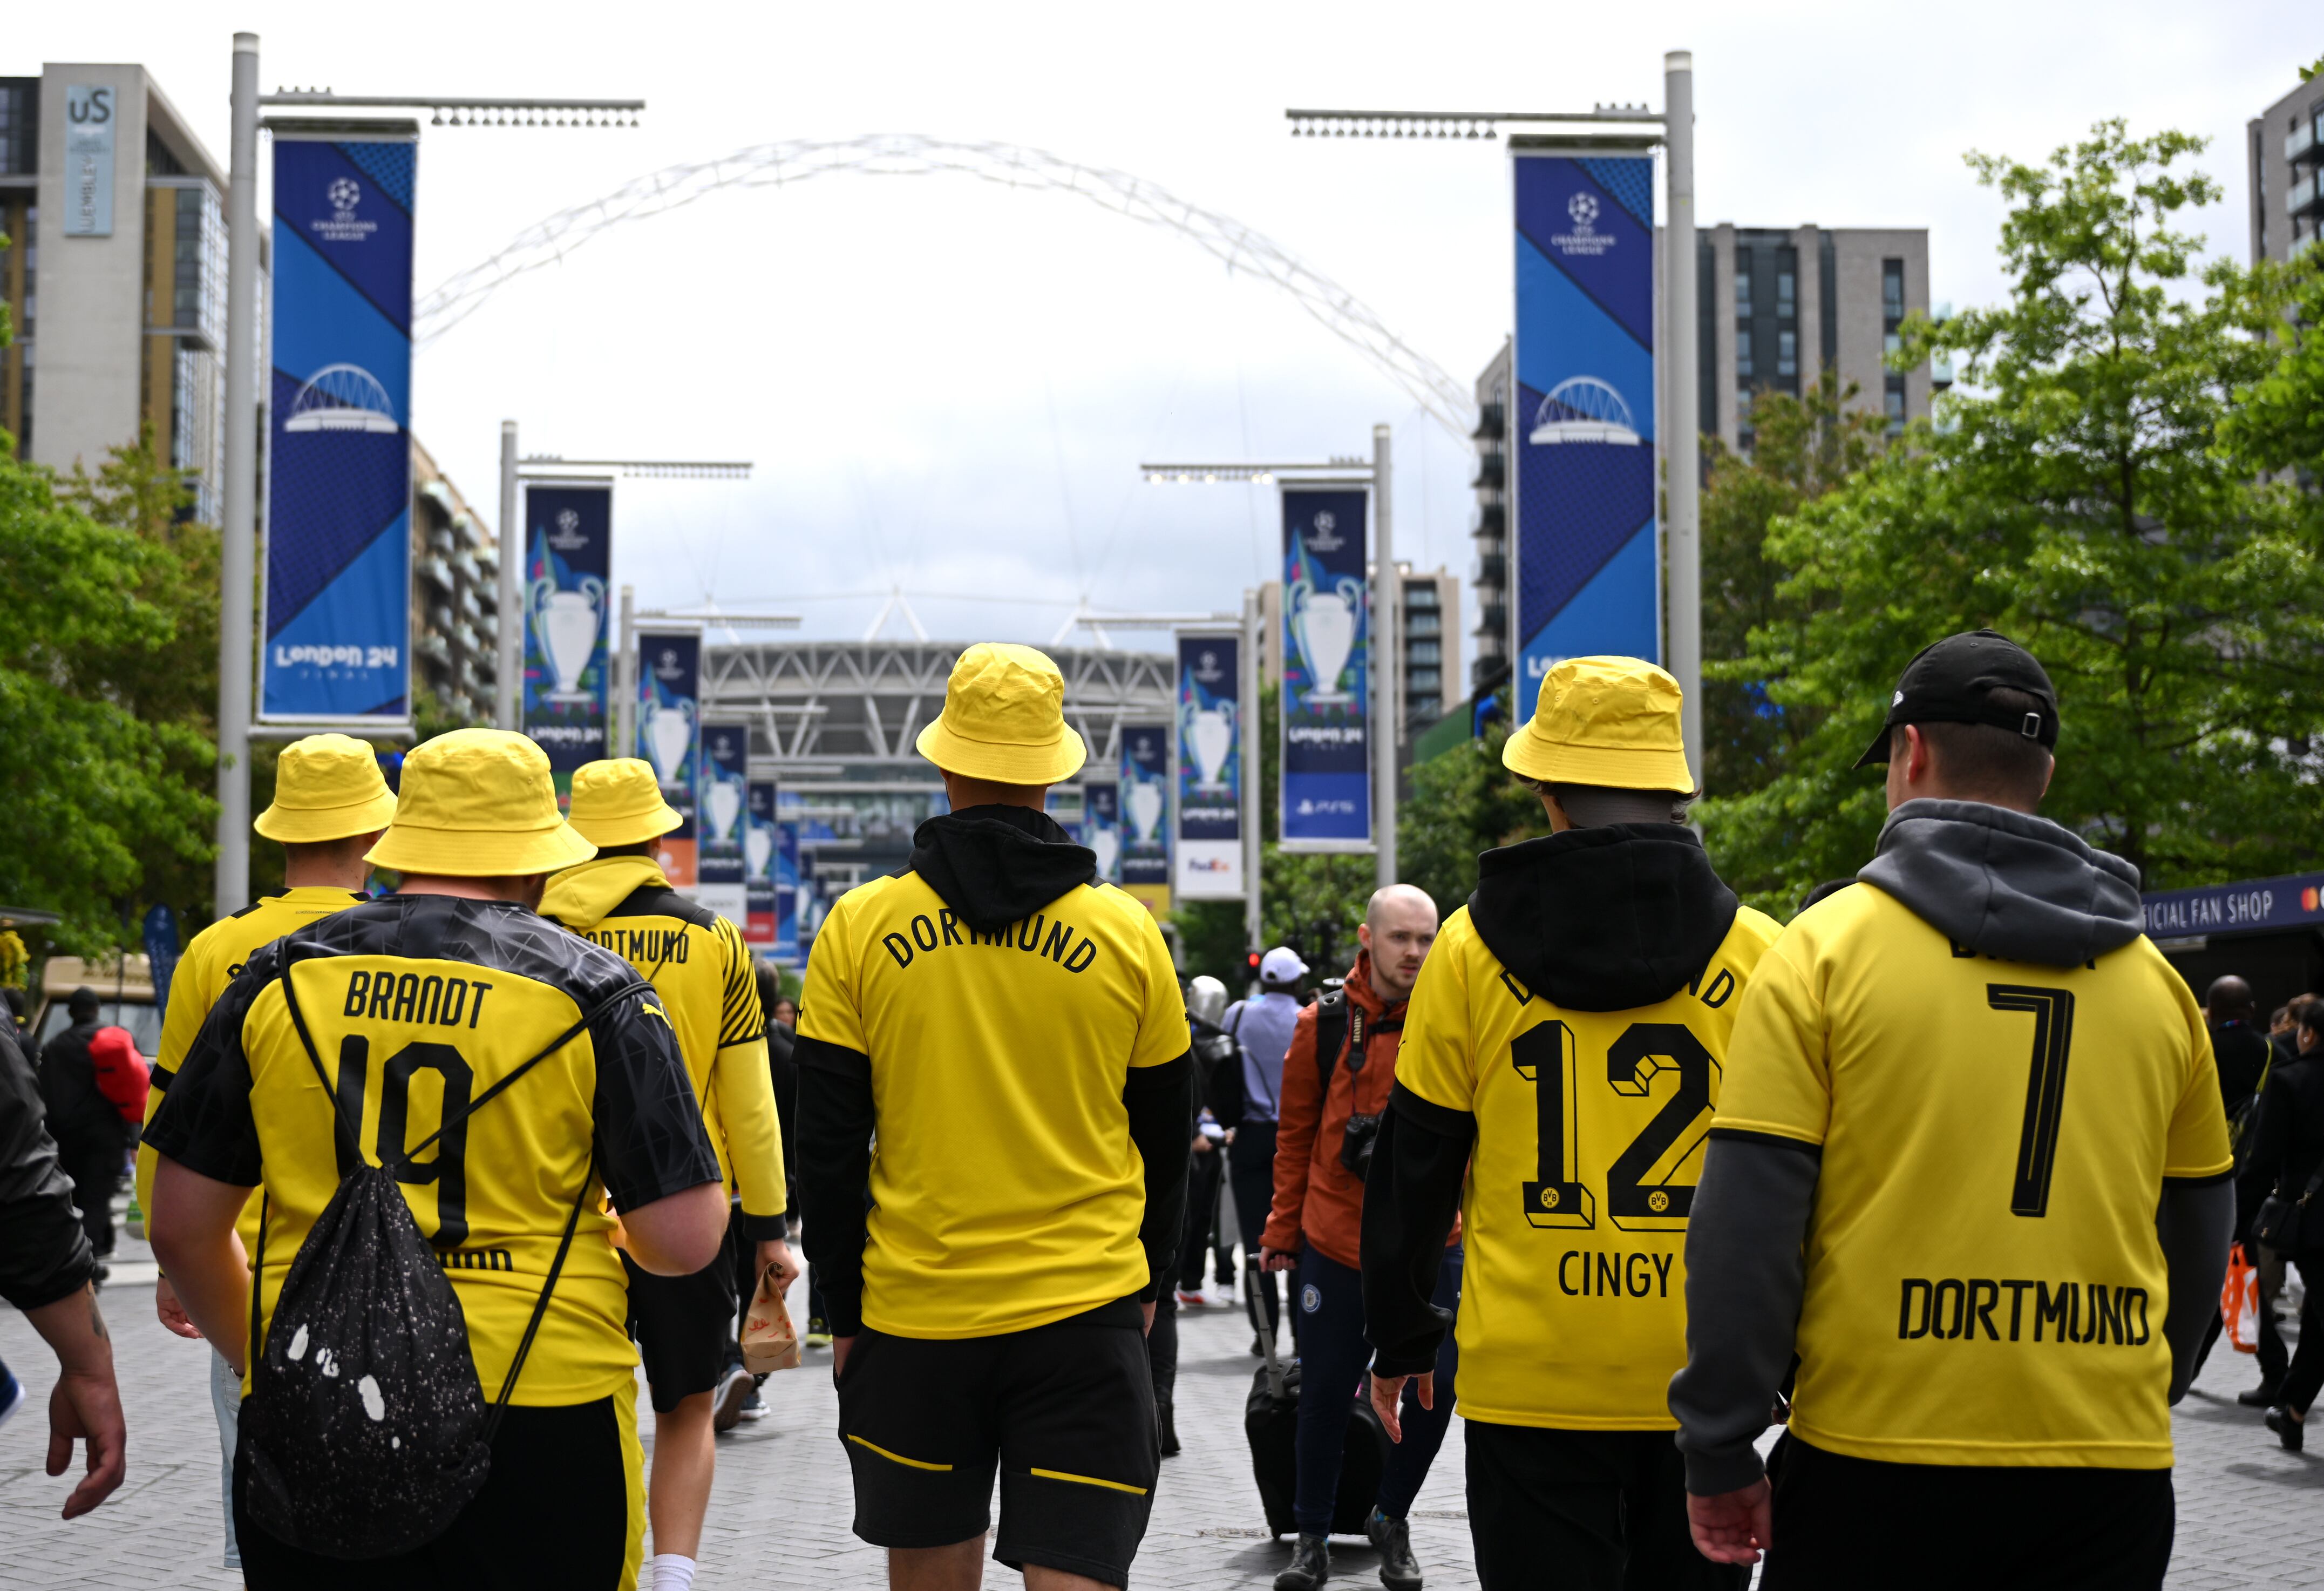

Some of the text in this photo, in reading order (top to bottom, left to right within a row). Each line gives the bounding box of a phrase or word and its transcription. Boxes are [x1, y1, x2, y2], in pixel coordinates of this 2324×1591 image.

[368, 646, 398, 668] 24
[2191, 897, 2221, 926] FAN
[2226, 891, 2273, 923] SHOP
[576, 929, 690, 964] RTMUND
[343, 971, 493, 1028] BRANDT
[1353, 1007, 1363, 1043] Canon
[1986, 983, 2075, 1217] 7
[334, 1034, 474, 1248] 19
[1511, 1020, 1722, 1233] 12
[1544, 1189, 1557, 1202] BVB
[1652, 1193, 1666, 1205] BVB
[1558, 1250, 1674, 1298] CINGY
[1898, 1278, 2150, 1346] DORTMUND
